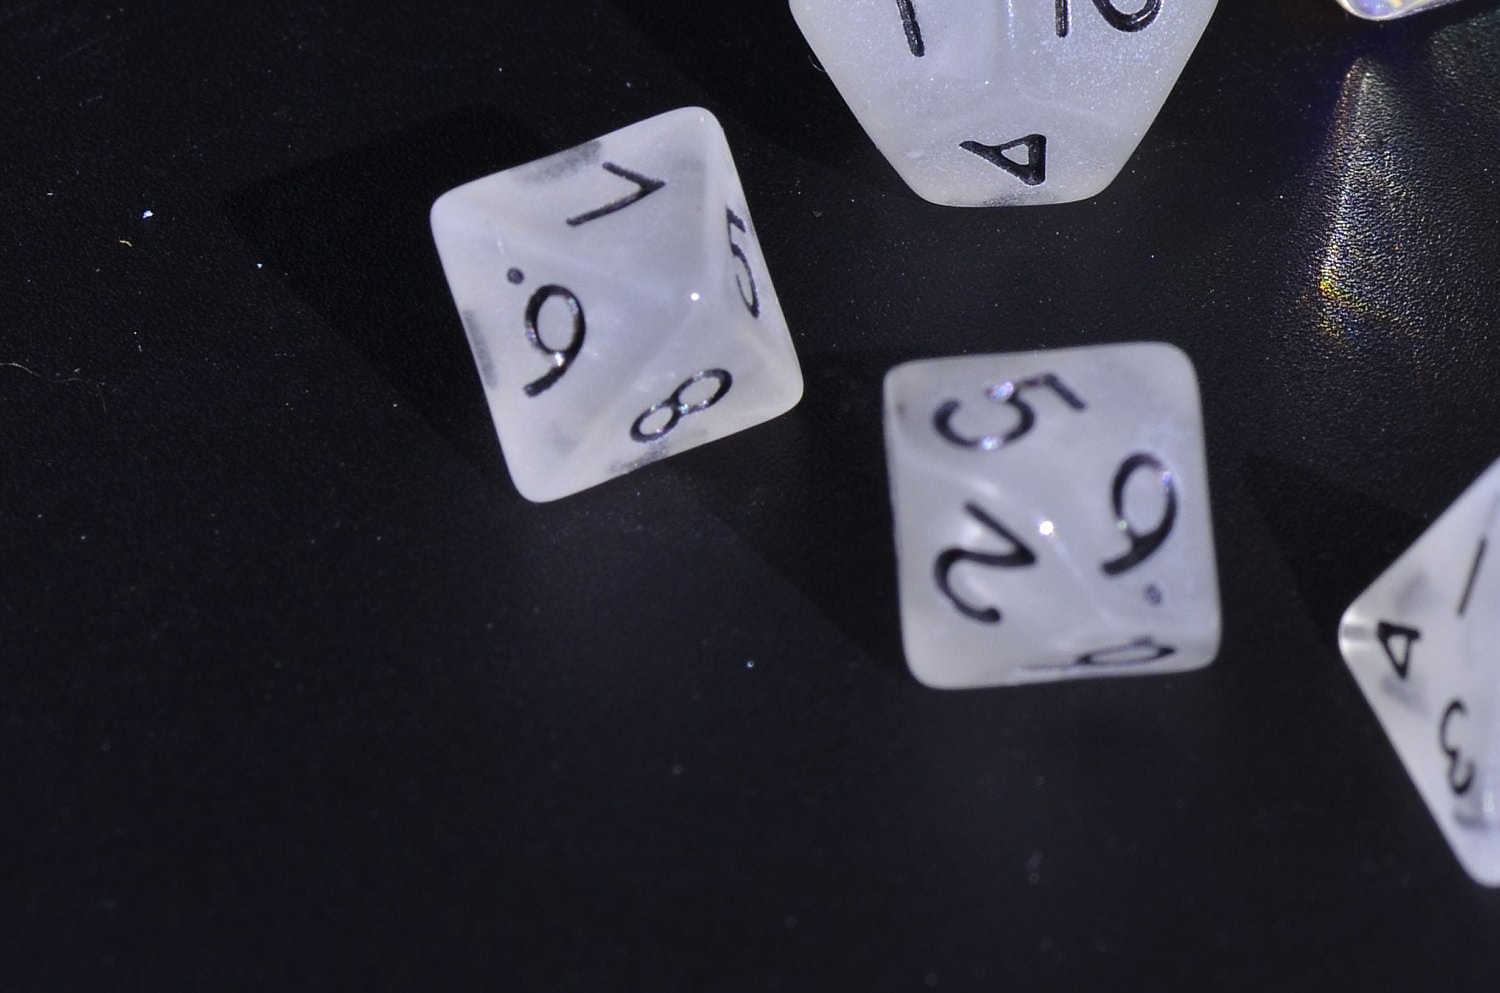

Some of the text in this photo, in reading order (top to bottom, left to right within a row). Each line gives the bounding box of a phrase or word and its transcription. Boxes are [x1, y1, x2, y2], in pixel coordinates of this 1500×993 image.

[566, 161, 667, 227] 7
[958, 133, 1047, 186] 4
[629, 368, 733, 443] 8
[932, 373, 1087, 450] 5
[933, 502, 1037, 625] 2
[1458, 537, 1487, 617] 1
[1376, 621, 1422, 680] 4
[1438, 699, 1475, 797] 3
